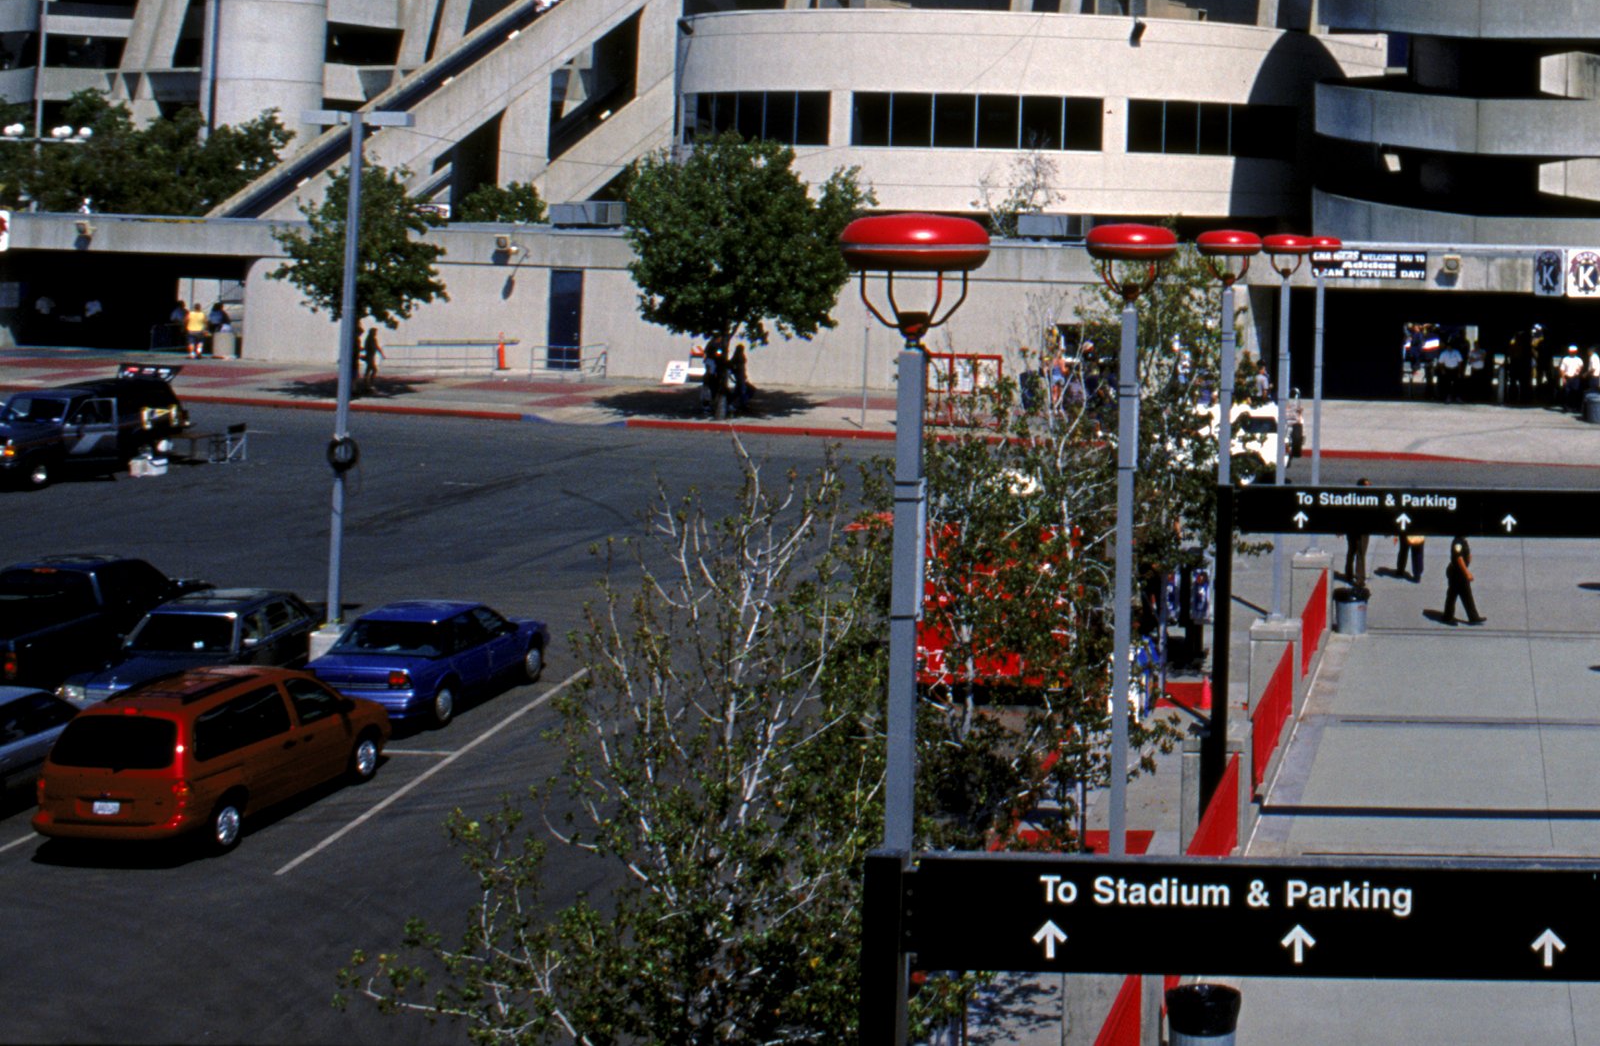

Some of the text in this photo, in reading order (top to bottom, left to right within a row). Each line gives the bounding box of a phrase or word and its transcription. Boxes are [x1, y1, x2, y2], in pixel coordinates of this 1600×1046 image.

[1362, 253, 1397, 262] WELCOME
[1399, 254, 1413, 262] YOU
[1415, 254, 1425, 262] TO
[1348, 269, 1396, 278] PICTURE
[1401, 270, 1425, 279] DAY!
[1542, 265, 1555, 286] K
[1579, 265, 1596, 288] K
[1296, 492, 1457, 510] To Stadium & Parking
[1040, 875, 1413, 917] To Stadium & Parking
